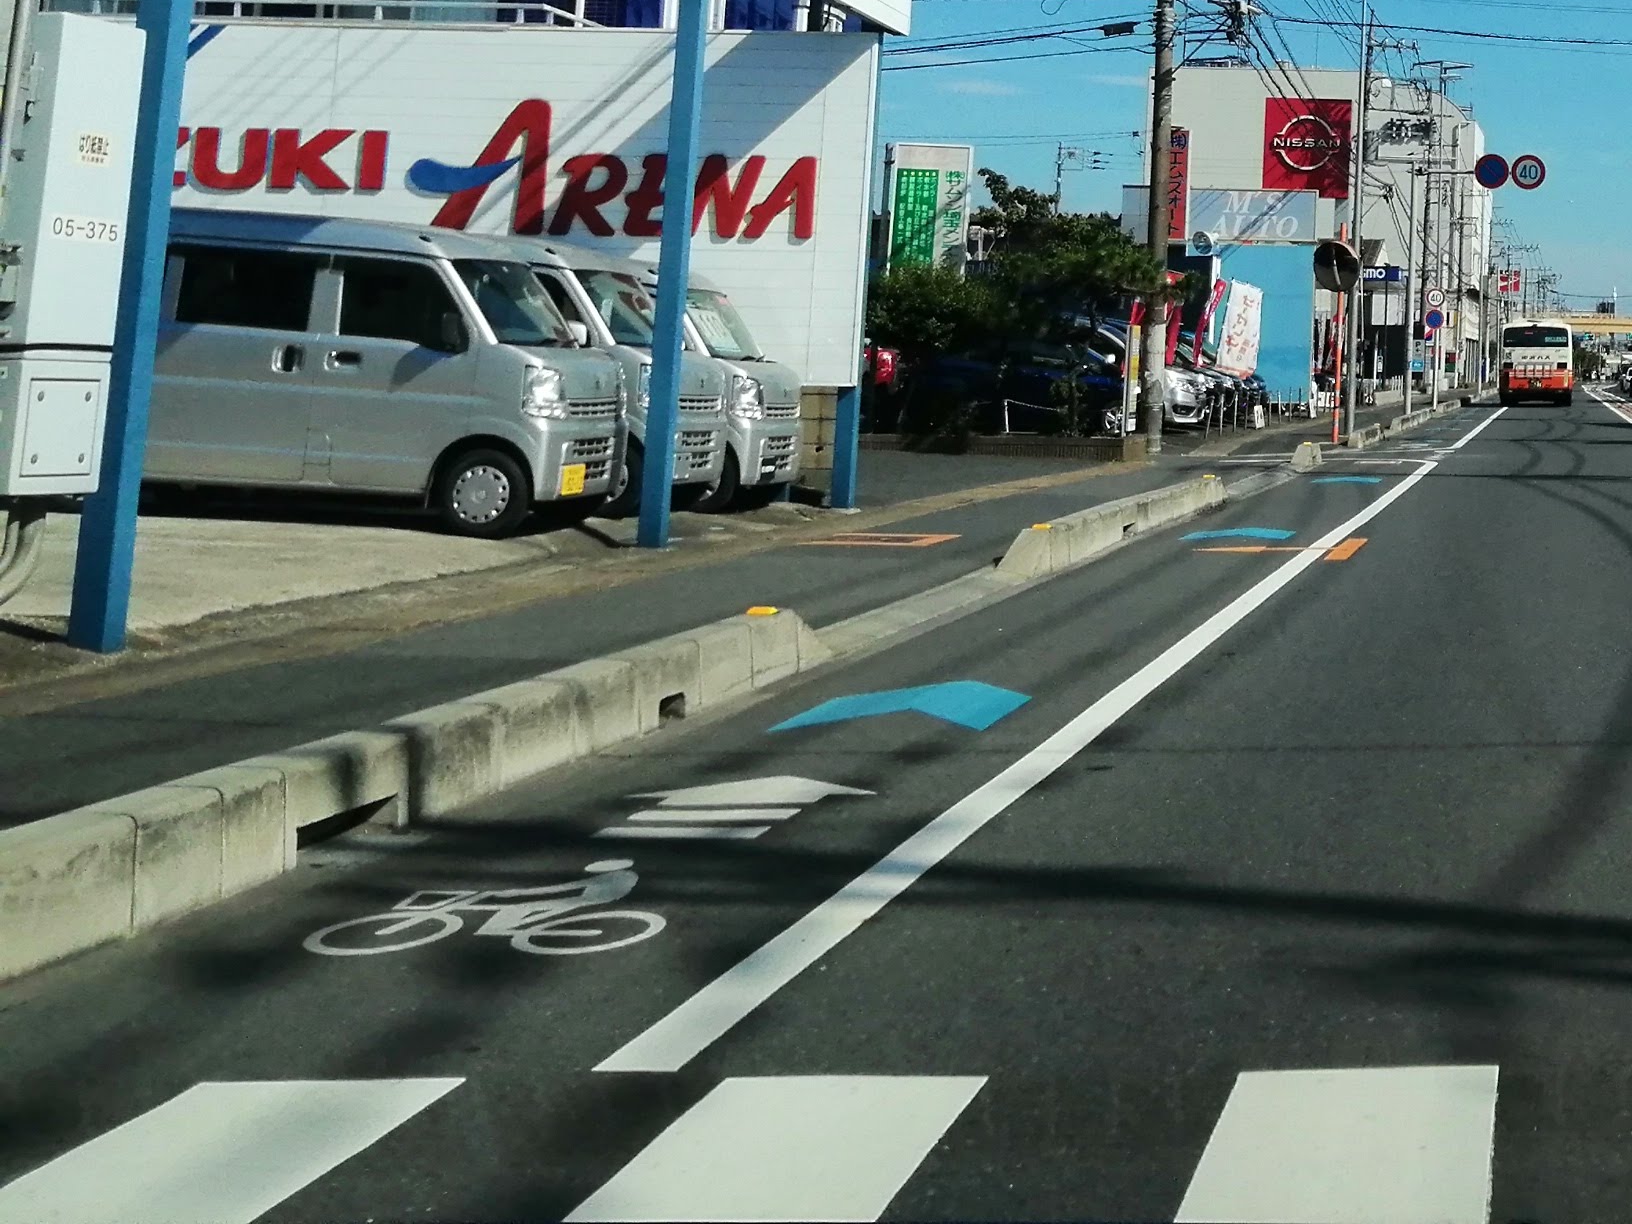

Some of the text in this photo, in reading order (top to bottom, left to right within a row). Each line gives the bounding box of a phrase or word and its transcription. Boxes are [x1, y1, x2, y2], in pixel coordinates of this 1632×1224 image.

[1273, 136, 1341, 148] NISSAN
[408, 99, 818, 239] ARENA
[1519, 164, 1539, 180] 40
[53, 217, 118, 242] 05-375
[1211, 215, 1299, 238] AUTO
[1430, 293, 1442, 303] 40
